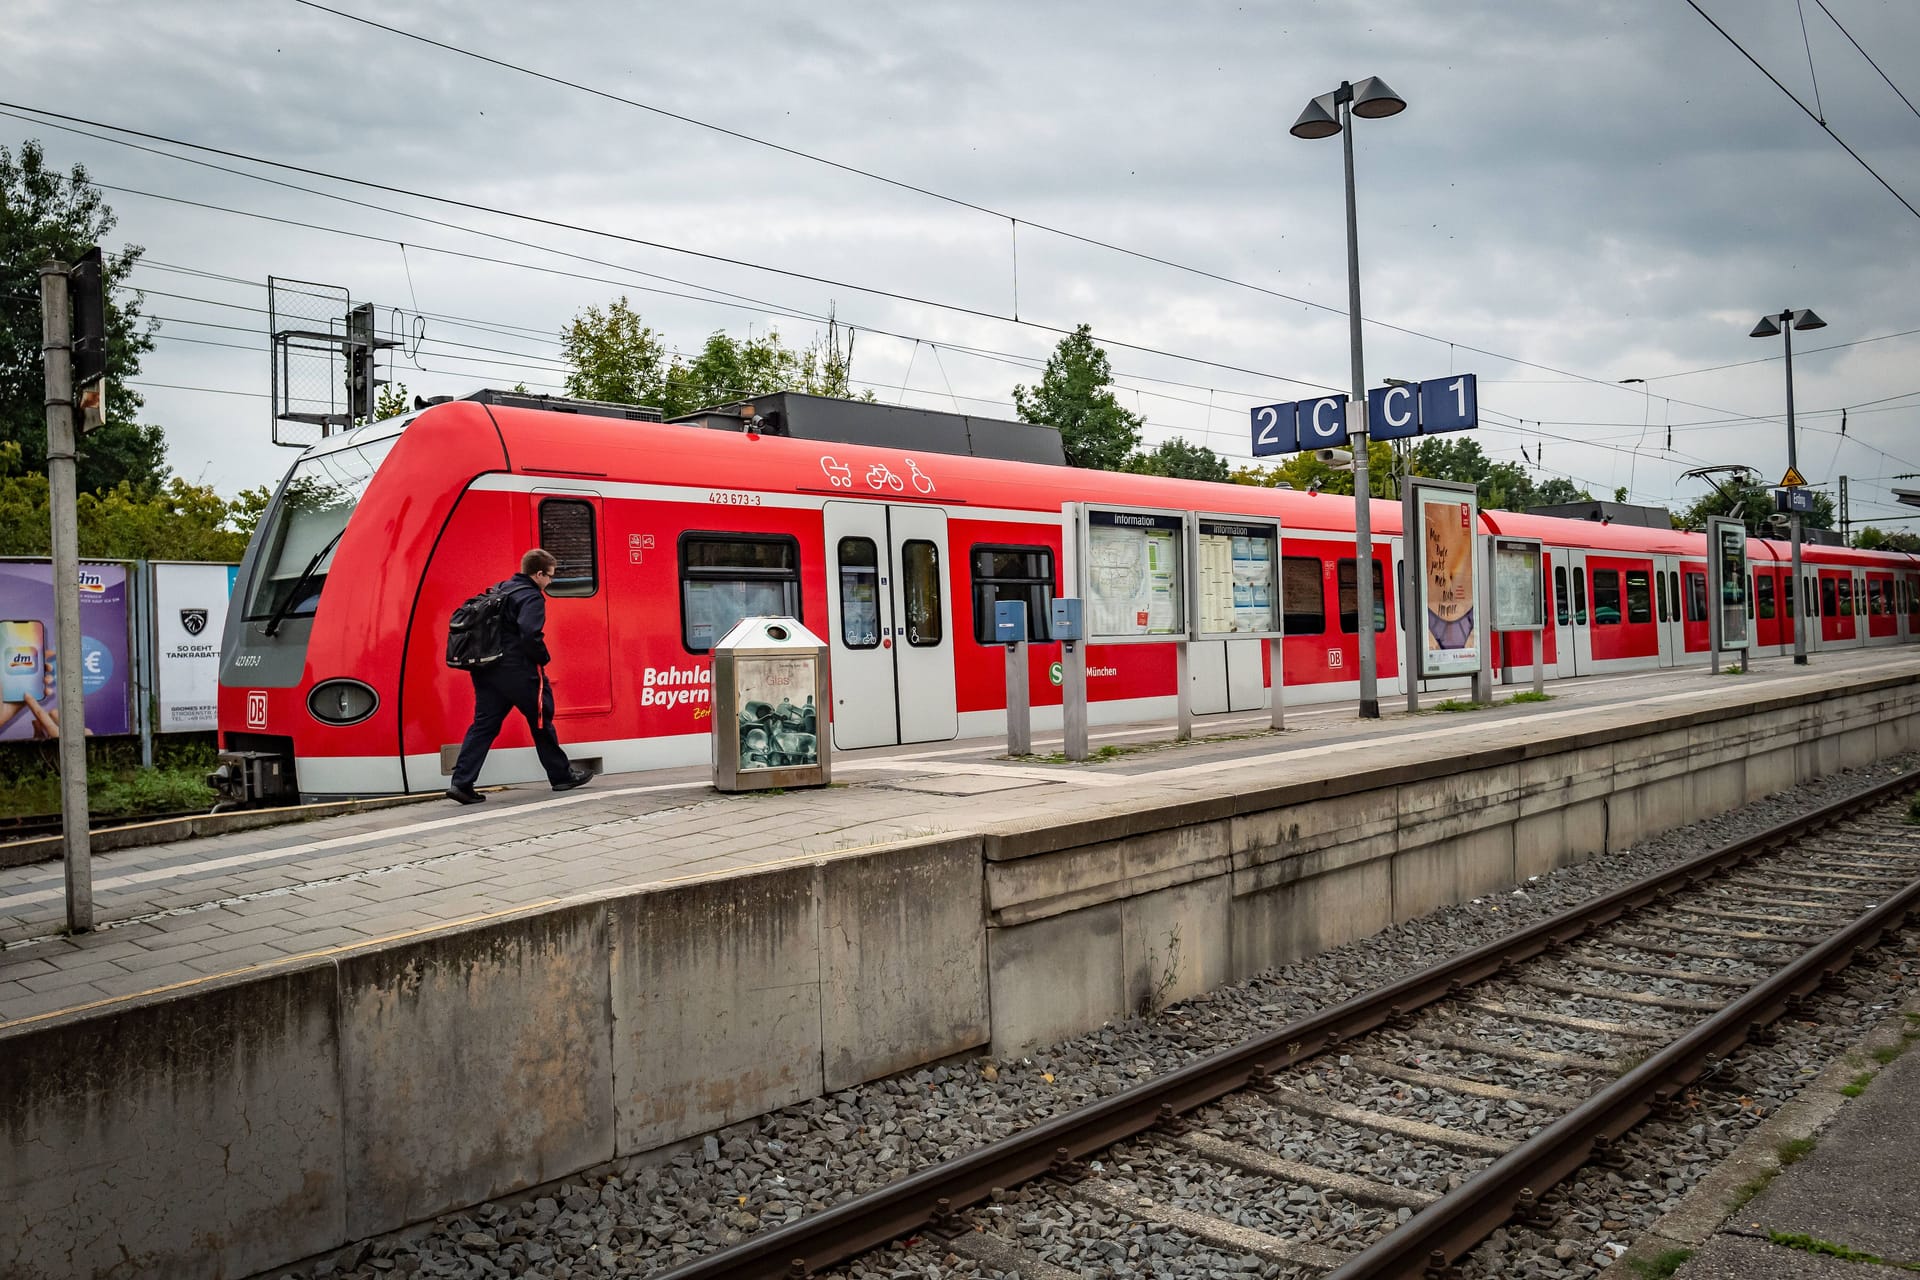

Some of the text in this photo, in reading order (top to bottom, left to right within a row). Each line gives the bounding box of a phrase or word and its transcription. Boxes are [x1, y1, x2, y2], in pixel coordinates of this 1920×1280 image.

[1383, 377, 1466, 427] C 1
[1256, 398, 1340, 445] 2 C
[709, 492, 761, 506] 423 673-3
[1114, 513, 1155, 527] Information
[1213, 524, 1248, 536] Information
[13, 653, 31, 663] dm
[84, 651, 101, 673] €
[1329, 651, 1341, 666] DB
[1086, 666, 1117, 677] München
[766, 674, 790, 686] Glas
[641, 687, 709, 710] Bayern
[249, 696, 266, 724] DB
